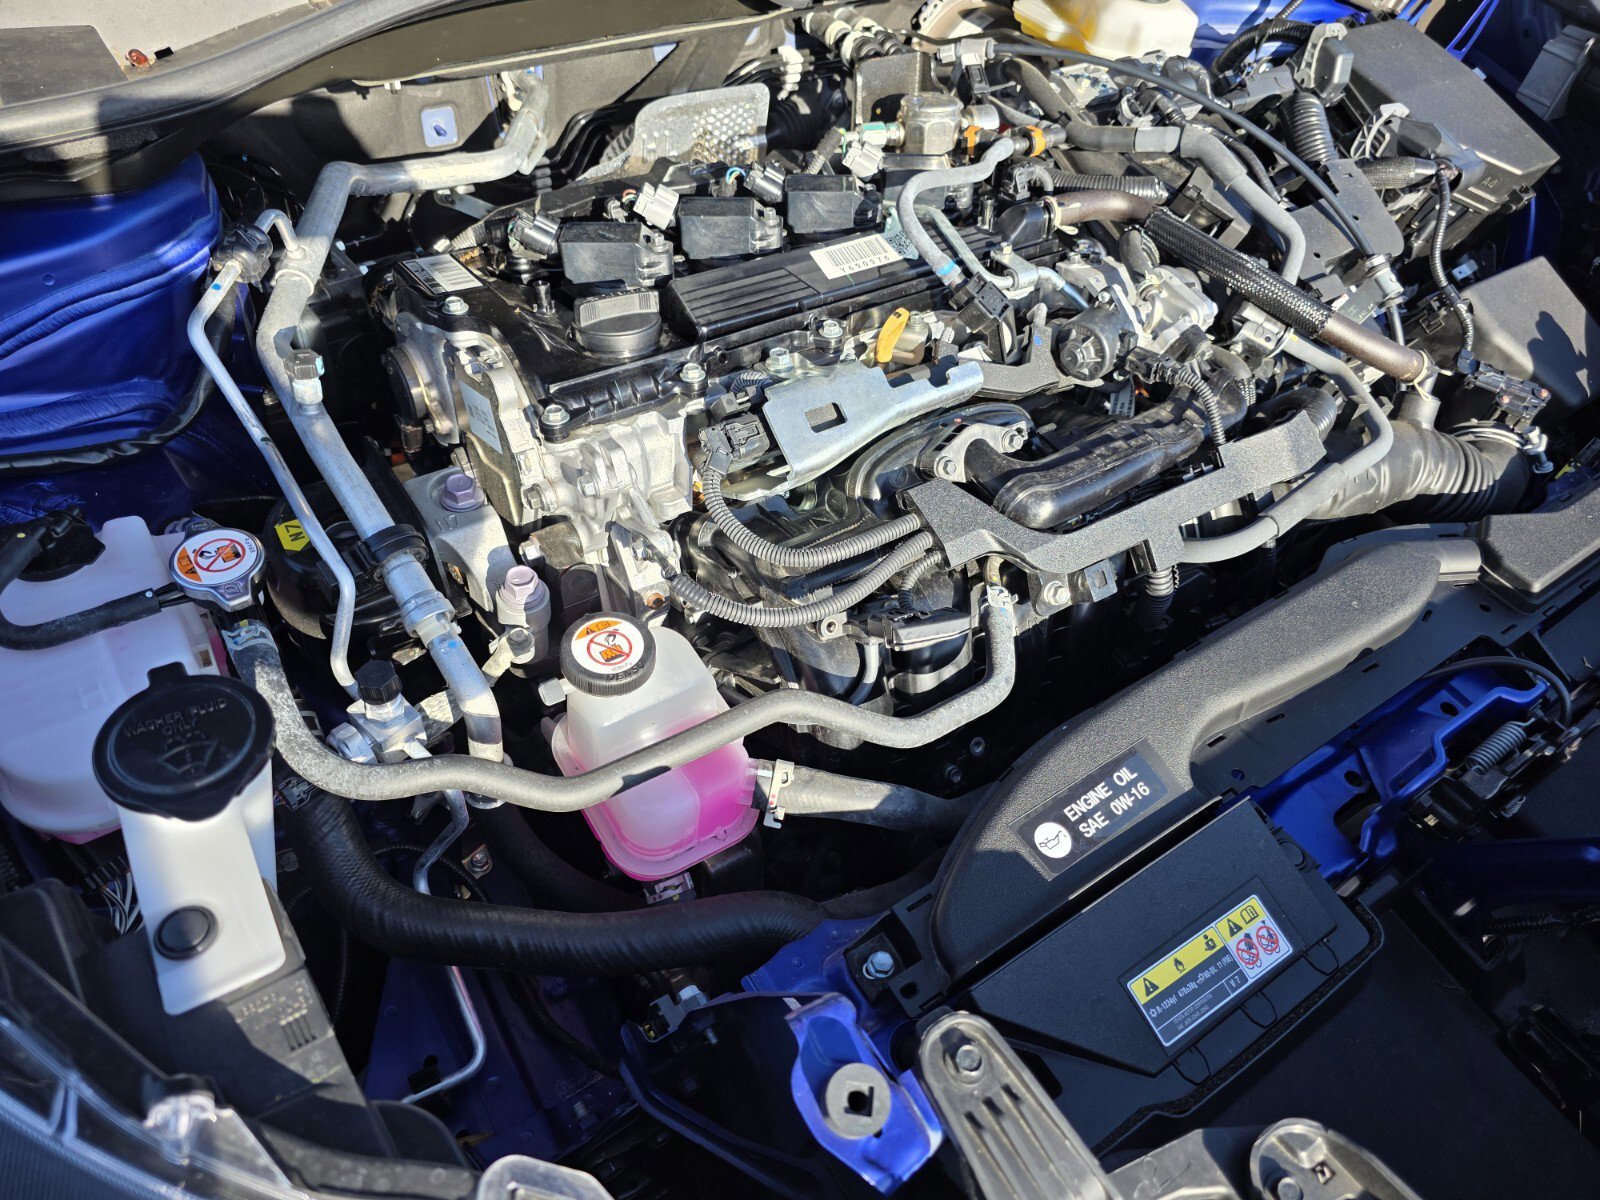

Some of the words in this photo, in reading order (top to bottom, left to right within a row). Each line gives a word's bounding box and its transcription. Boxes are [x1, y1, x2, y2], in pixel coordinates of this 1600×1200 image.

[605, 661, 645, 681] DENSO
[190, 697, 228, 716] FLUID
[162, 718, 199, 736] ONLY
[1063, 782, 1113, 822] ENGINE
[1113, 767, 1138, 787] OIL
[1078, 811, 1110, 838] SAE
[1109, 782, 1150, 815] 0W-16
